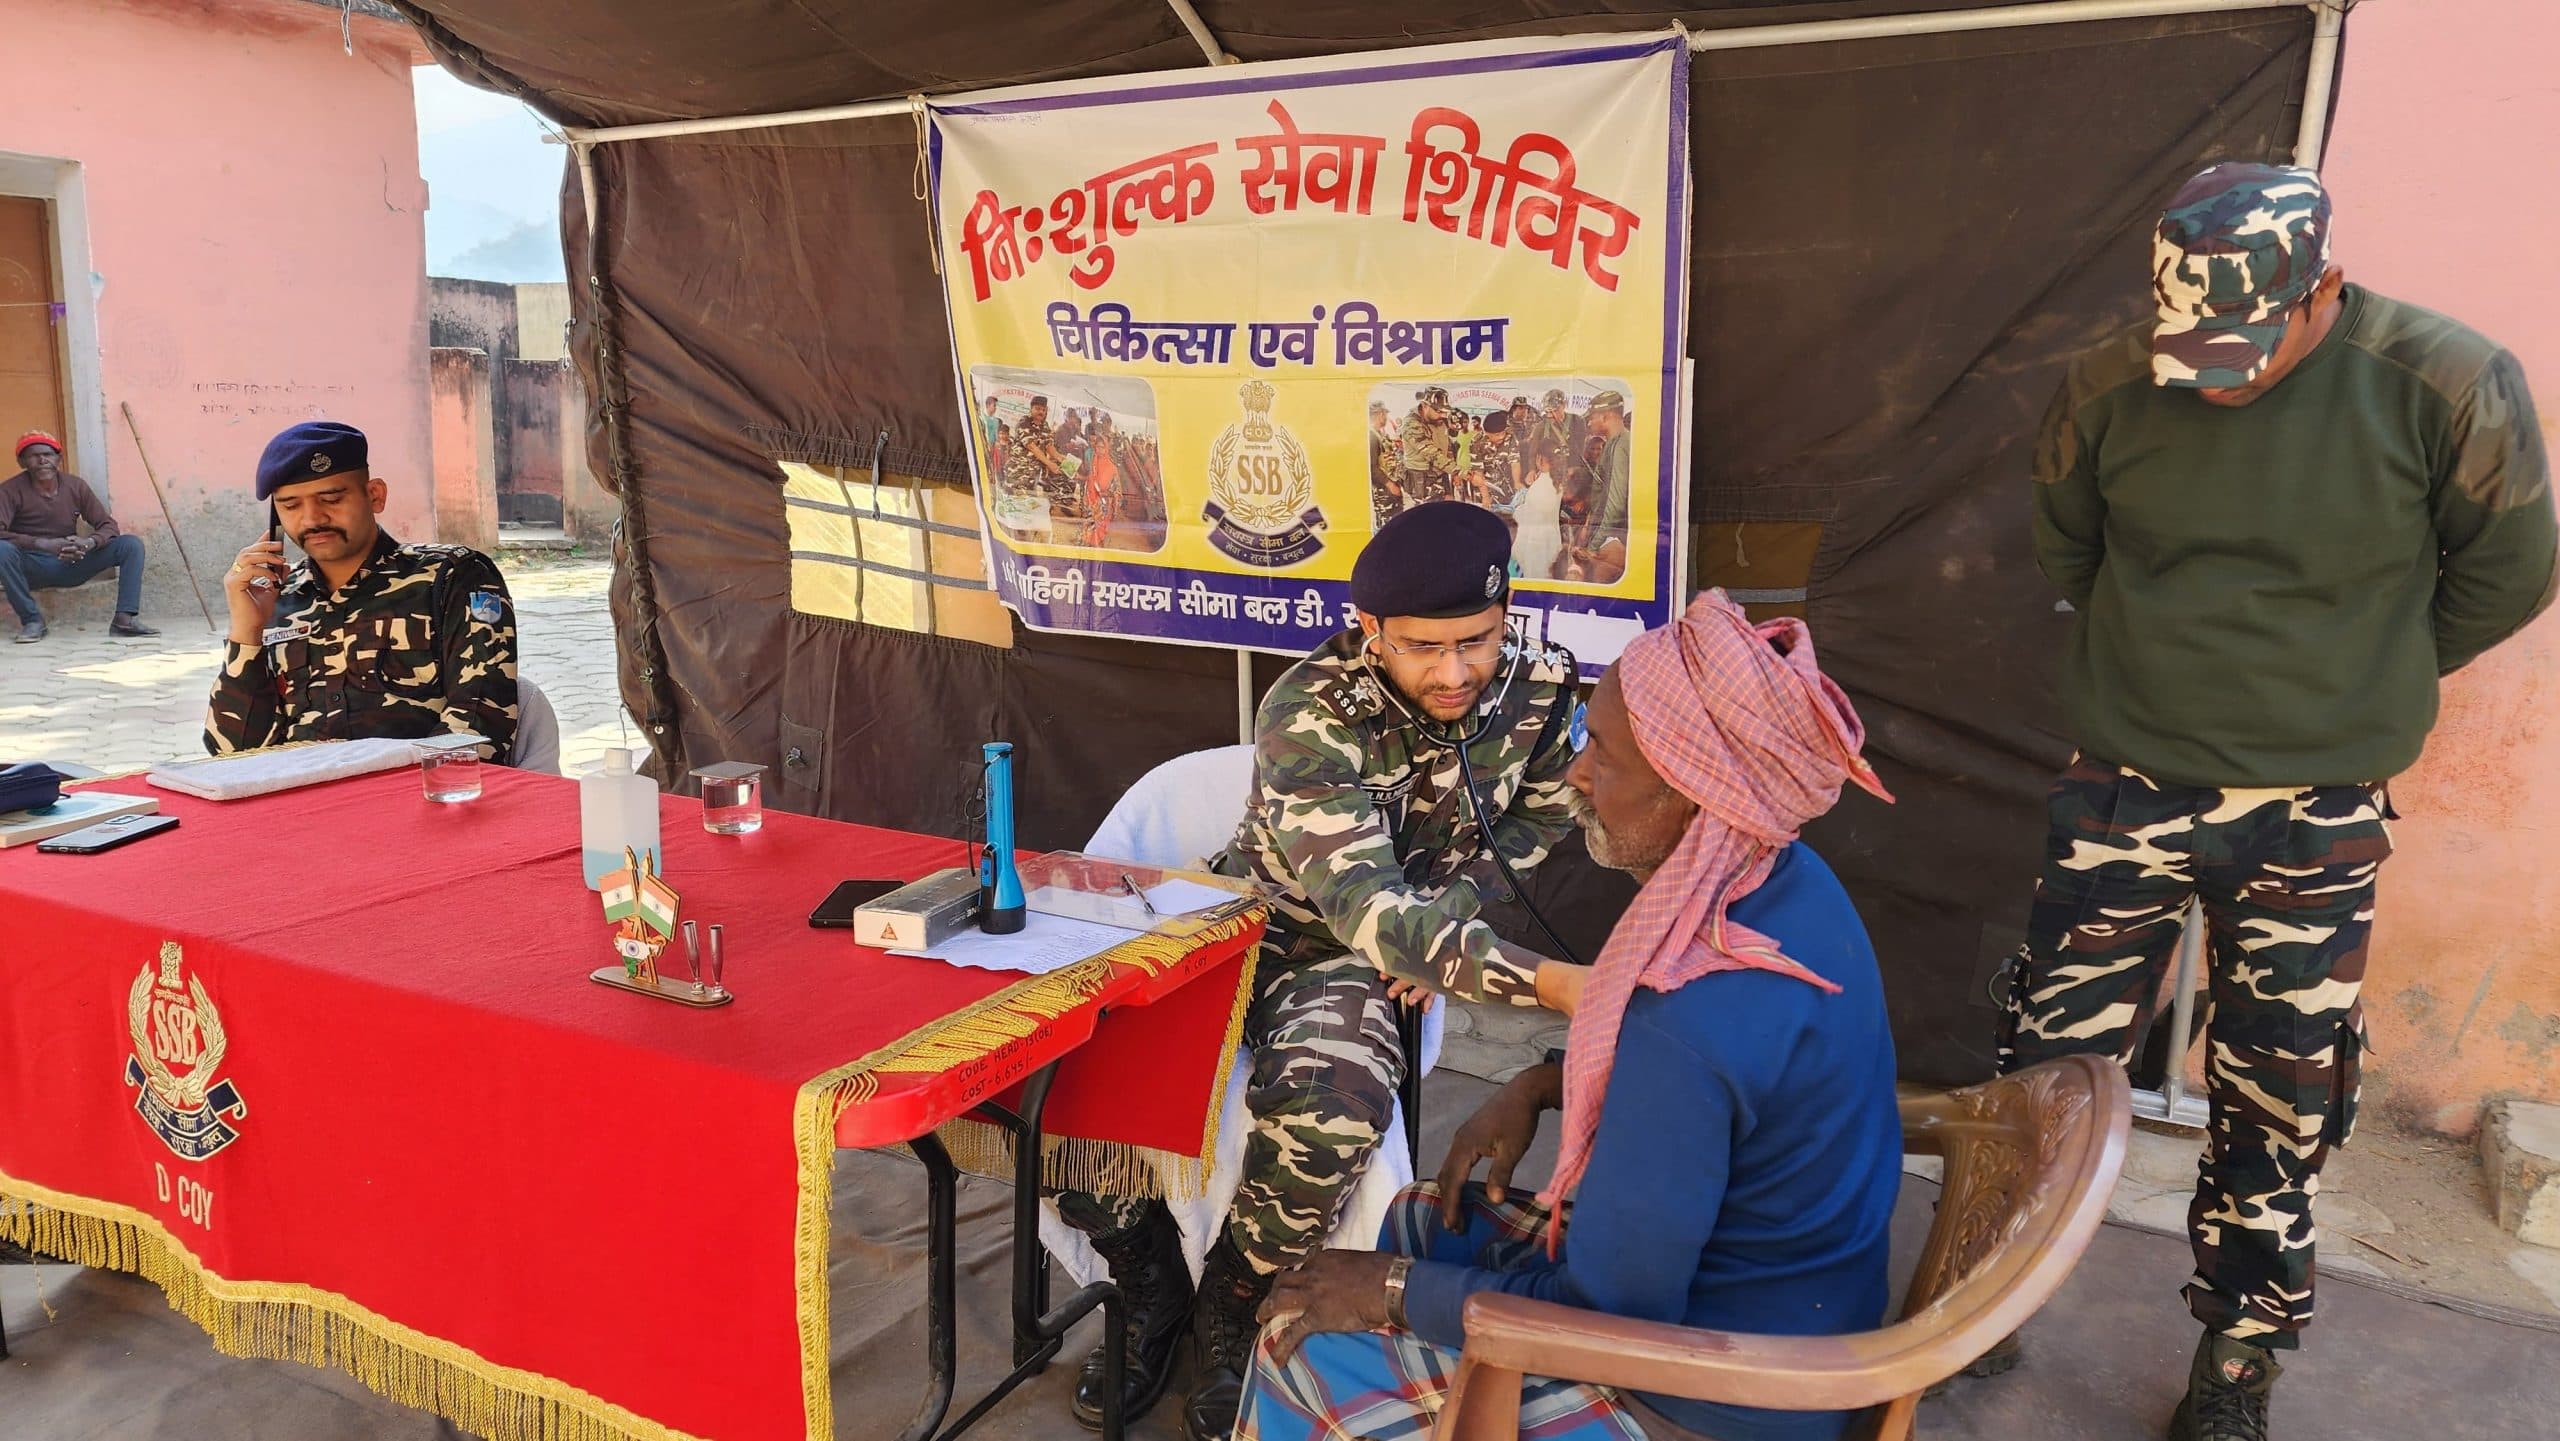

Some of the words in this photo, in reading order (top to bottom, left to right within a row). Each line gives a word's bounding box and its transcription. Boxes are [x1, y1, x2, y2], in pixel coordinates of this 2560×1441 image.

[960, 141, 1218, 302] निःशुल्क
[1235, 98, 1386, 215] सेवा
[1403, 107, 1640, 292] शिविर
[1046, 302, 1236, 364] चिकित्सा
[1249, 305, 1327, 366] एवं
[1331, 301, 1509, 366] विश्राम
[1237, 454, 1283, 495] SSB
[1092, 581, 1172, 613] सशस्त्र
[1178, 579, 1237, 620] सीमा
[1243, 596, 1290, 625] बल
[1295, 588, 1333, 629] डी.
[1333, 689, 1357, 716] SSB
[152, 999, 197, 1065] SSB
[958, 1057, 989, 1084] CODE
[155, 1161, 172, 1203] D
[177, 1174, 214, 1232] COY
